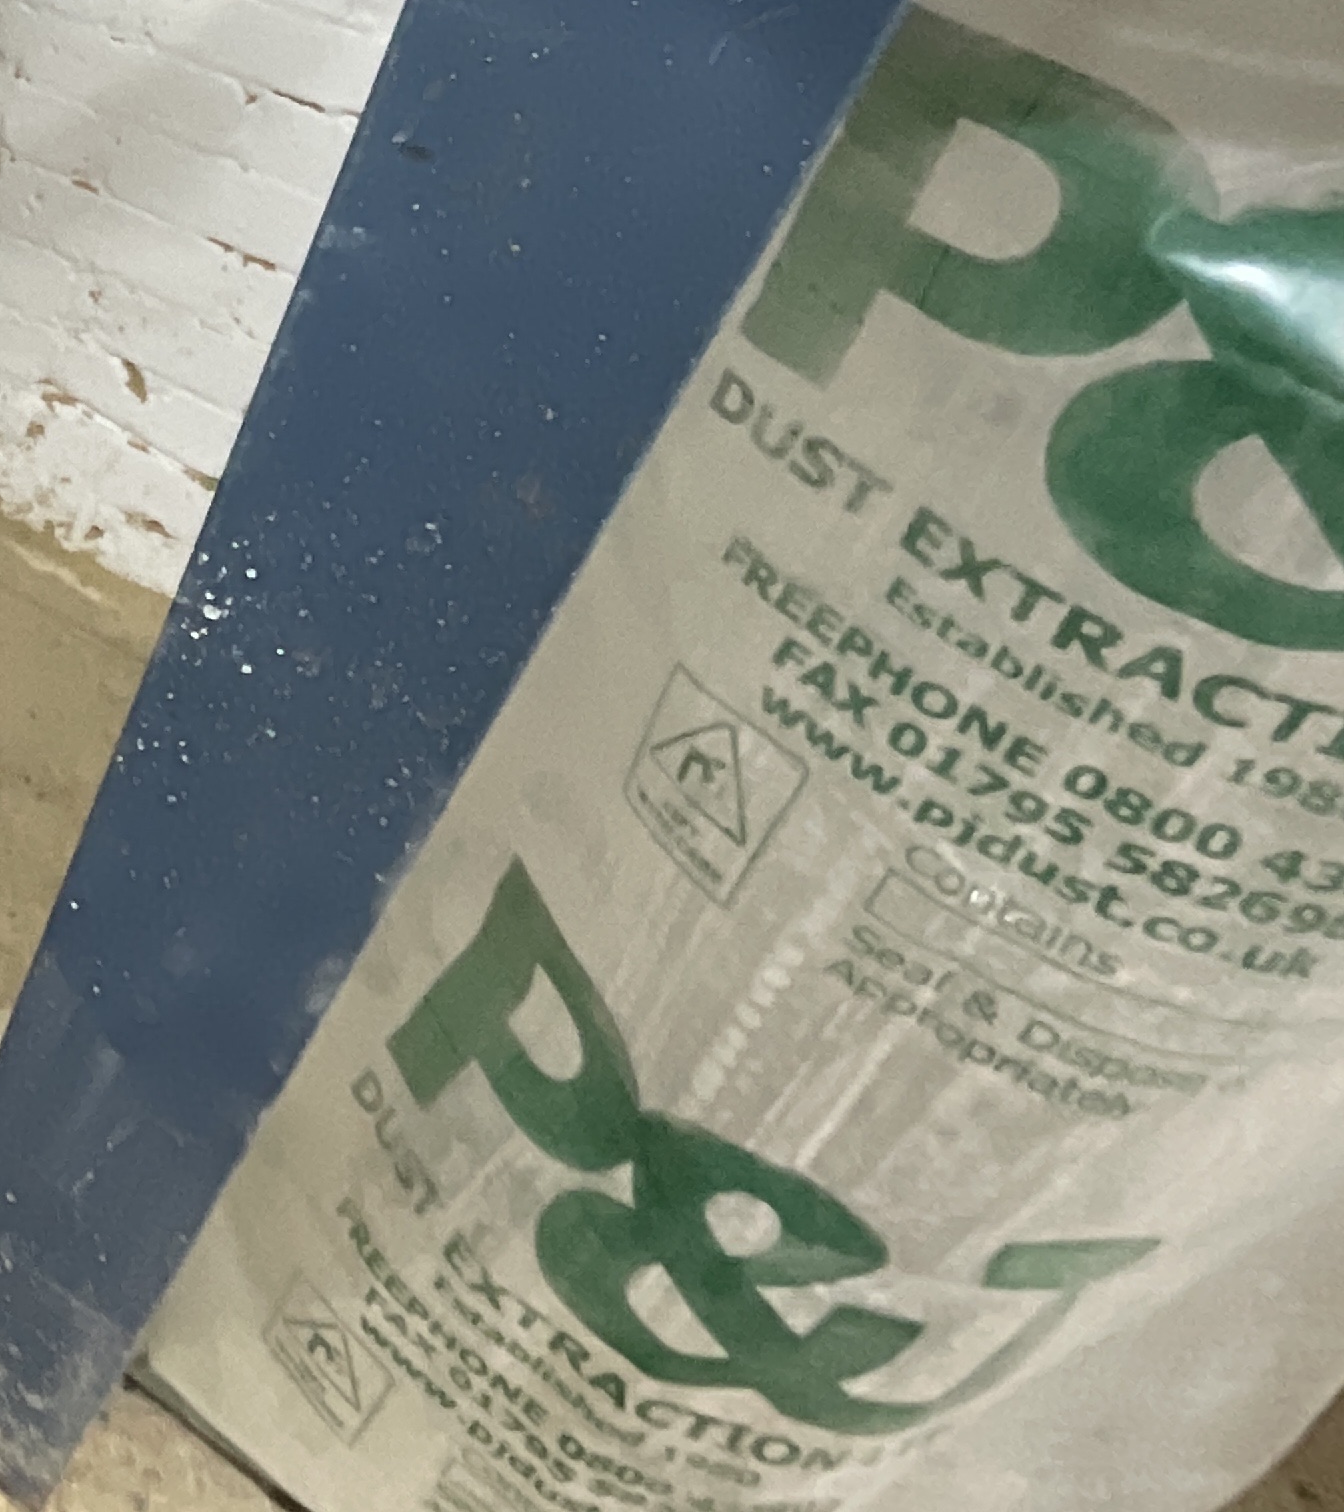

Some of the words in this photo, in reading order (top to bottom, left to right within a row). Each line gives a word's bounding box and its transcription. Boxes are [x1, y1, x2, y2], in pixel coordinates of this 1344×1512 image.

[707, 368, 893, 516] DUST
[900, 506, 1344, 764] EXTRACT
[722, 536, 1048, 778] FREEPHONE
[1063, 764, 1244, 860] 0800
[885, 576, 1207, 769] Established
[1226, 758, 1344, 824] 198
[762, 687, 1316, 978] www.pjdust.co.uk
[771, 638, 879, 729] FAX
[887, 722, 1094, 846] 01795
[843, 924, 962, 994] Seal
[962, 990, 999, 1026] &
[905, 846, 1125, 976] Contains
[350, 1065, 444, 1216] DUST
[443, 1232, 853, 1470] EXTRACTION
